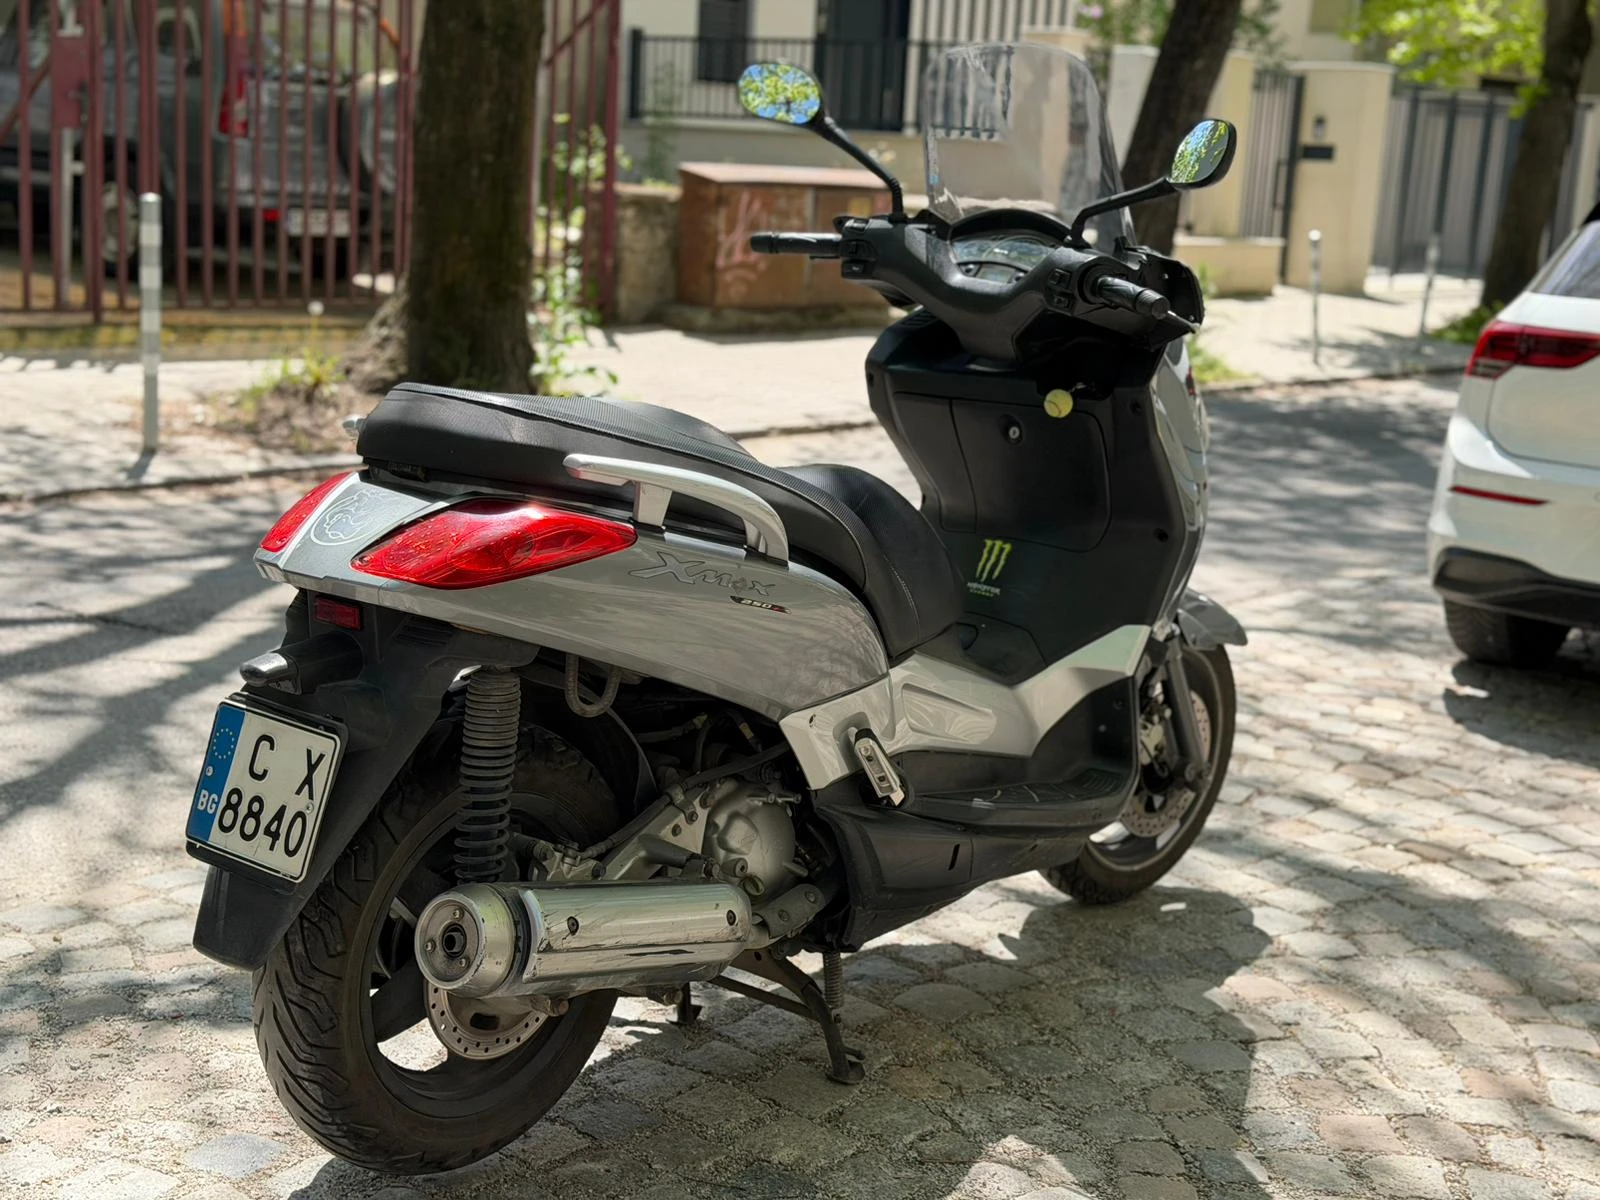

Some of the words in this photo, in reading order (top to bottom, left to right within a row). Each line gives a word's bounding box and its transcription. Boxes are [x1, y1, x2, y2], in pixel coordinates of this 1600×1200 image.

[249, 734, 275, 781] C
[295, 748, 325, 801] X
[197, 790, 219, 814] BG
[218, 787, 307, 858] 8840
